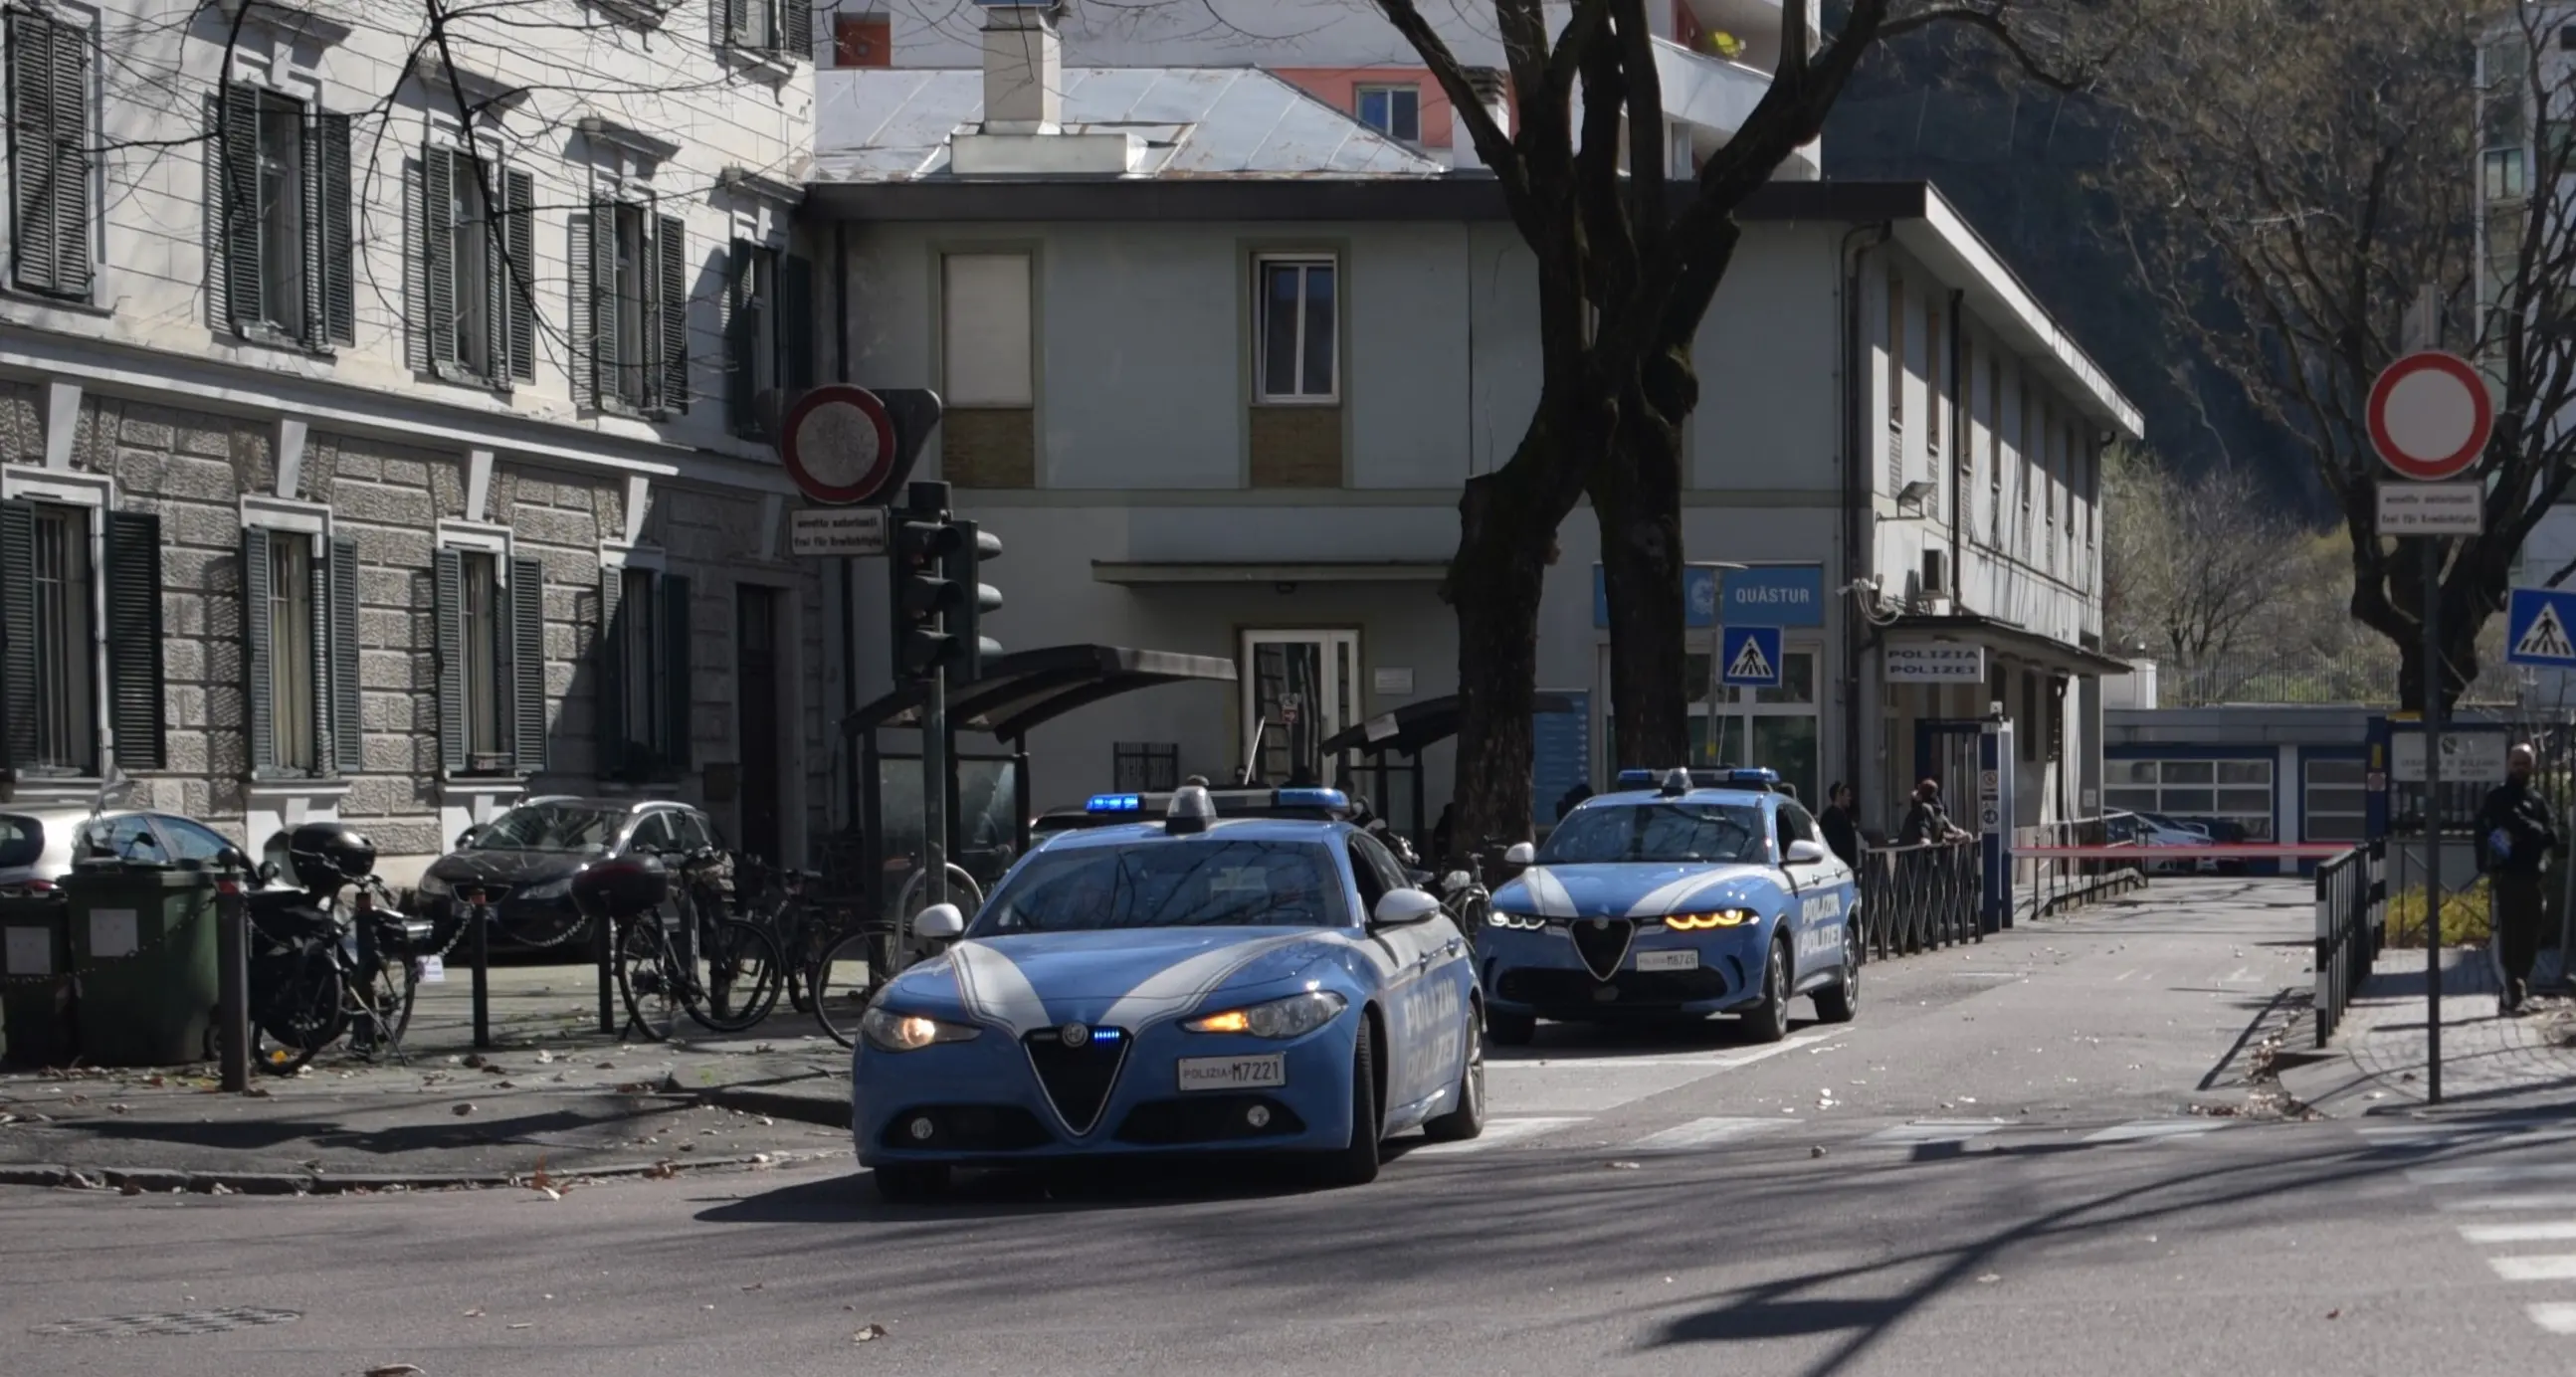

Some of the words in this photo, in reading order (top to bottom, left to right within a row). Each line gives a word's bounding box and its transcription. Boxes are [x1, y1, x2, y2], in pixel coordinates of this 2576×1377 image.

[1735, 585, 1810, 604] QUÄSTUR
[1888, 649, 1979, 660] POLIZIA
[1889, 665, 1976, 675] POLIZEI
[1802, 892, 1841, 925] POLIZIA
[1800, 921, 1843, 958] POLIZEI
[1403, 977, 1459, 1039] POLIZIA
[1183, 1067, 1227, 1080] POLIZIA
[1232, 1061, 1280, 1082] M7221
